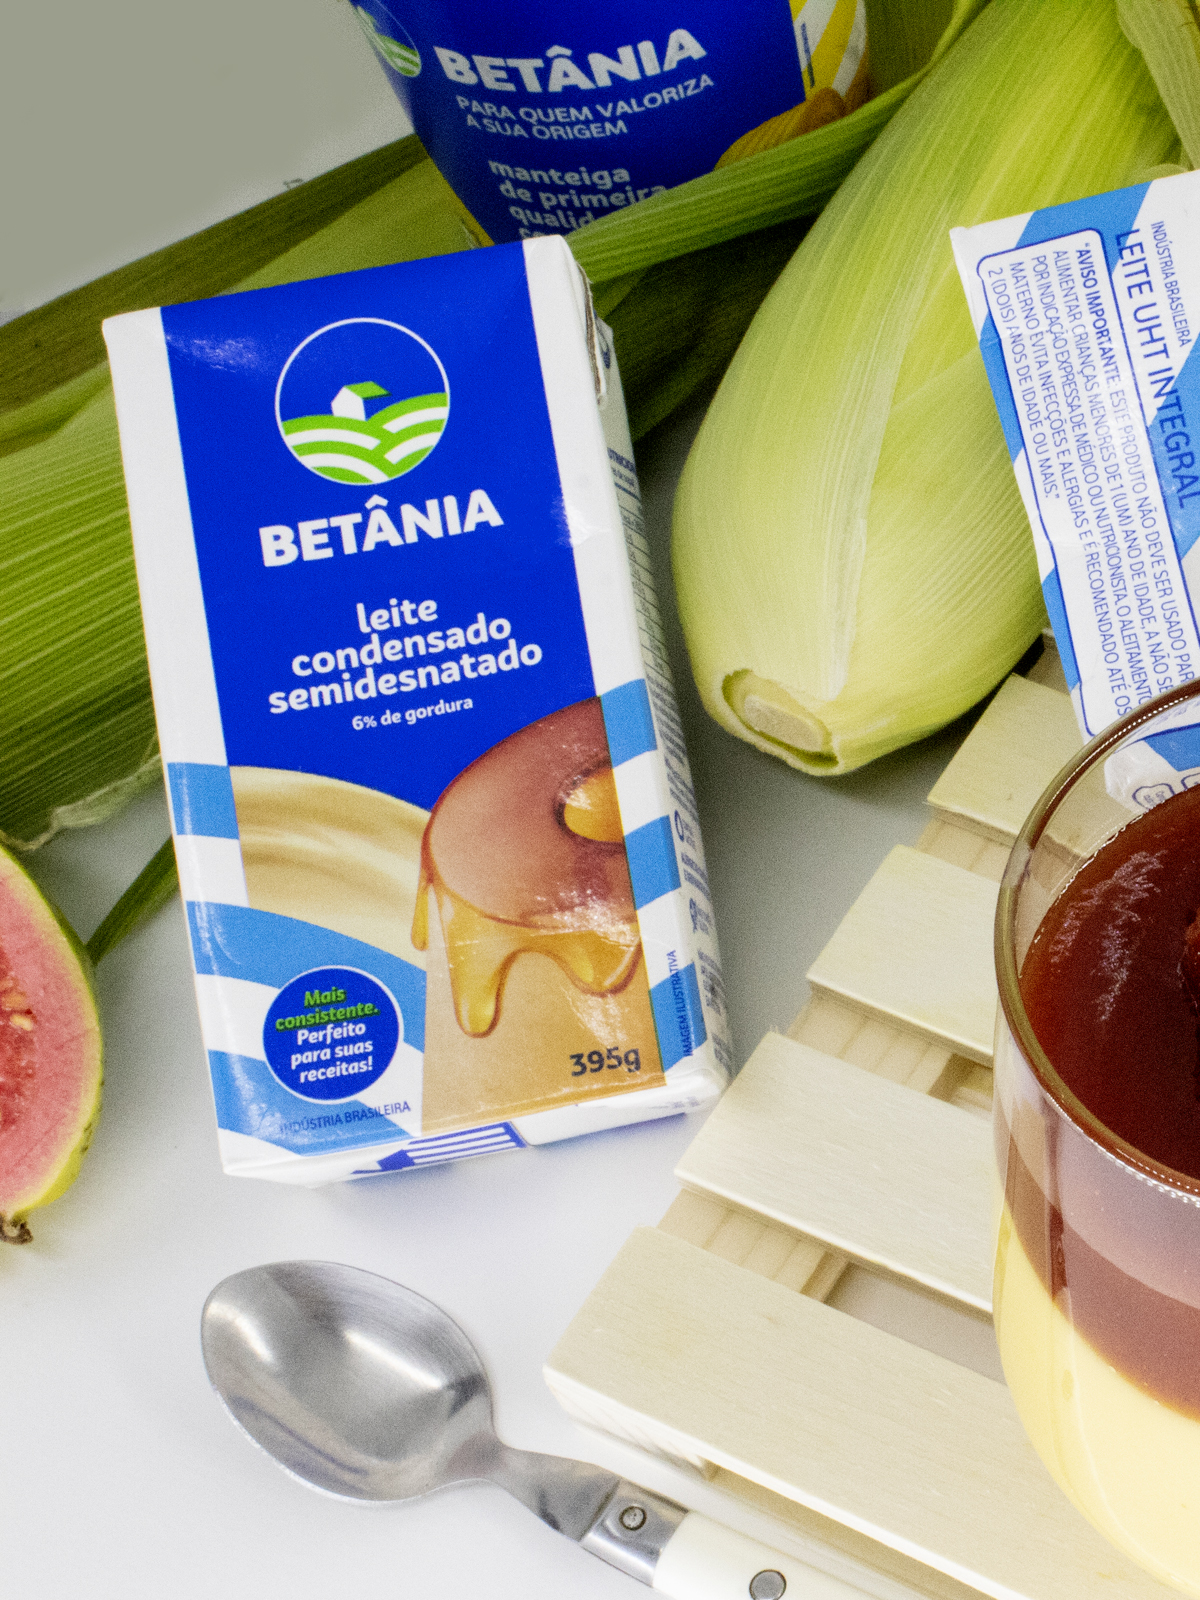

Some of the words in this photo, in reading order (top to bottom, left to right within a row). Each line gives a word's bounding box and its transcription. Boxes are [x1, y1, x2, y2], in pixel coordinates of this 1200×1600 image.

[433, 29, 707, 93] BETÂNIA
[456, 95, 517, 121] PARA
[519, 106, 594, 126] QUEM
[596, 74, 715, 118] VALORIZA
[466, 113, 481, 130] A
[482, 118, 529, 139] SUA
[531, 120, 628, 140] ORIGEM
[488, 160, 631, 190] manteiga
[499, 179, 534, 203] de
[987, 266, 1004, 279] 2
[1031, 254, 1051, 283] POR
[1115, 228, 1154, 299] LEITE
[990, 278, 1017, 324] (DOIS)
[1009, 261, 1041, 330] MATERNO
[1052, 250, 1083, 324] ALIMENTAR
[1150, 220, 1176, 281] INDÚSTRIA
[1164, 279, 1193, 348] BRASILEIRA
[1037, 281, 1069, 350] INDICAÇÃO
[1132, 302, 1170, 359] UHT
[1005, 325, 1028, 365] ANOS
[1029, 331, 1050, 371] EVITA
[1066, 323, 1100, 392] CRIANÇAS
[1015, 364, 1033, 386] DE
[1054, 349, 1082, 415] EXPRESSA
[1021, 386, 1044, 431] IDADE
[1038, 370, 1069, 448] INFECÇÕES
[1069, 412, 1088, 433] DE
[1109, 389, 1132, 423] ESTE
[1032, 431, 1050, 456] OU
[1087, 393, 1117, 463] MENORES
[1056, 448, 1072, 460] E
[1074, 432, 1100, 485] MÉDICO
[1118, 424, 1148, 495] PRODUTO
[1103, 462, 1123, 484] DE
[1109, 483, 1125, 492] 1
[1058, 461, 1090, 529] ALERGIAS
[1086, 484, 1106, 507] OU
[1110, 492, 1135, 527] (UM)
[1135, 495, 1158, 529] NÃO
[258, 488, 504, 568] BETÂNIA
[1078, 529, 1094, 541] E
[1121, 529, 1143, 560] ANO
[1082, 541, 1101, 552] É
[1144, 530, 1167, 569] DEVE
[1128, 560, 1147, 582] DE
[1152, 569, 1174, 599] SER
[356, 598, 438, 633] leite
[1085, 551, 1120, 665] RECOMENDADO
[1115, 604, 1132, 618] O
[1133, 581, 1158, 630] IDADE,
[1144, 630, 1161, 640] A
[1160, 599, 1188, 651] USADO
[291, 612, 512, 677] condensado
[1147, 641, 1171, 675] NÃO
[268, 638, 543, 714] semidesnatado
[1106, 667, 1132, 694] ATÉ
[351, 715, 378, 731] 6%
[380, 709, 402, 726] de
[405, 697, 474, 725] gordura
[303, 986, 347, 1009] Mais
[666, 949, 686, 1014] ILUSTRATIVA
[275, 1002, 381, 1032] consistente.
[297, 1021, 367, 1046] Perfeito
[678, 1015, 694, 1057] IMAGEM
[291, 1048, 332, 1070] para
[334, 1041, 374, 1059] suas
[300, 1056, 374, 1084] receitas!
[569, 1046, 642, 1078] 395g
[279, 1113, 344, 1135] INDÚSTRIA
[344, 1100, 412, 1124] BRASILEIRA
